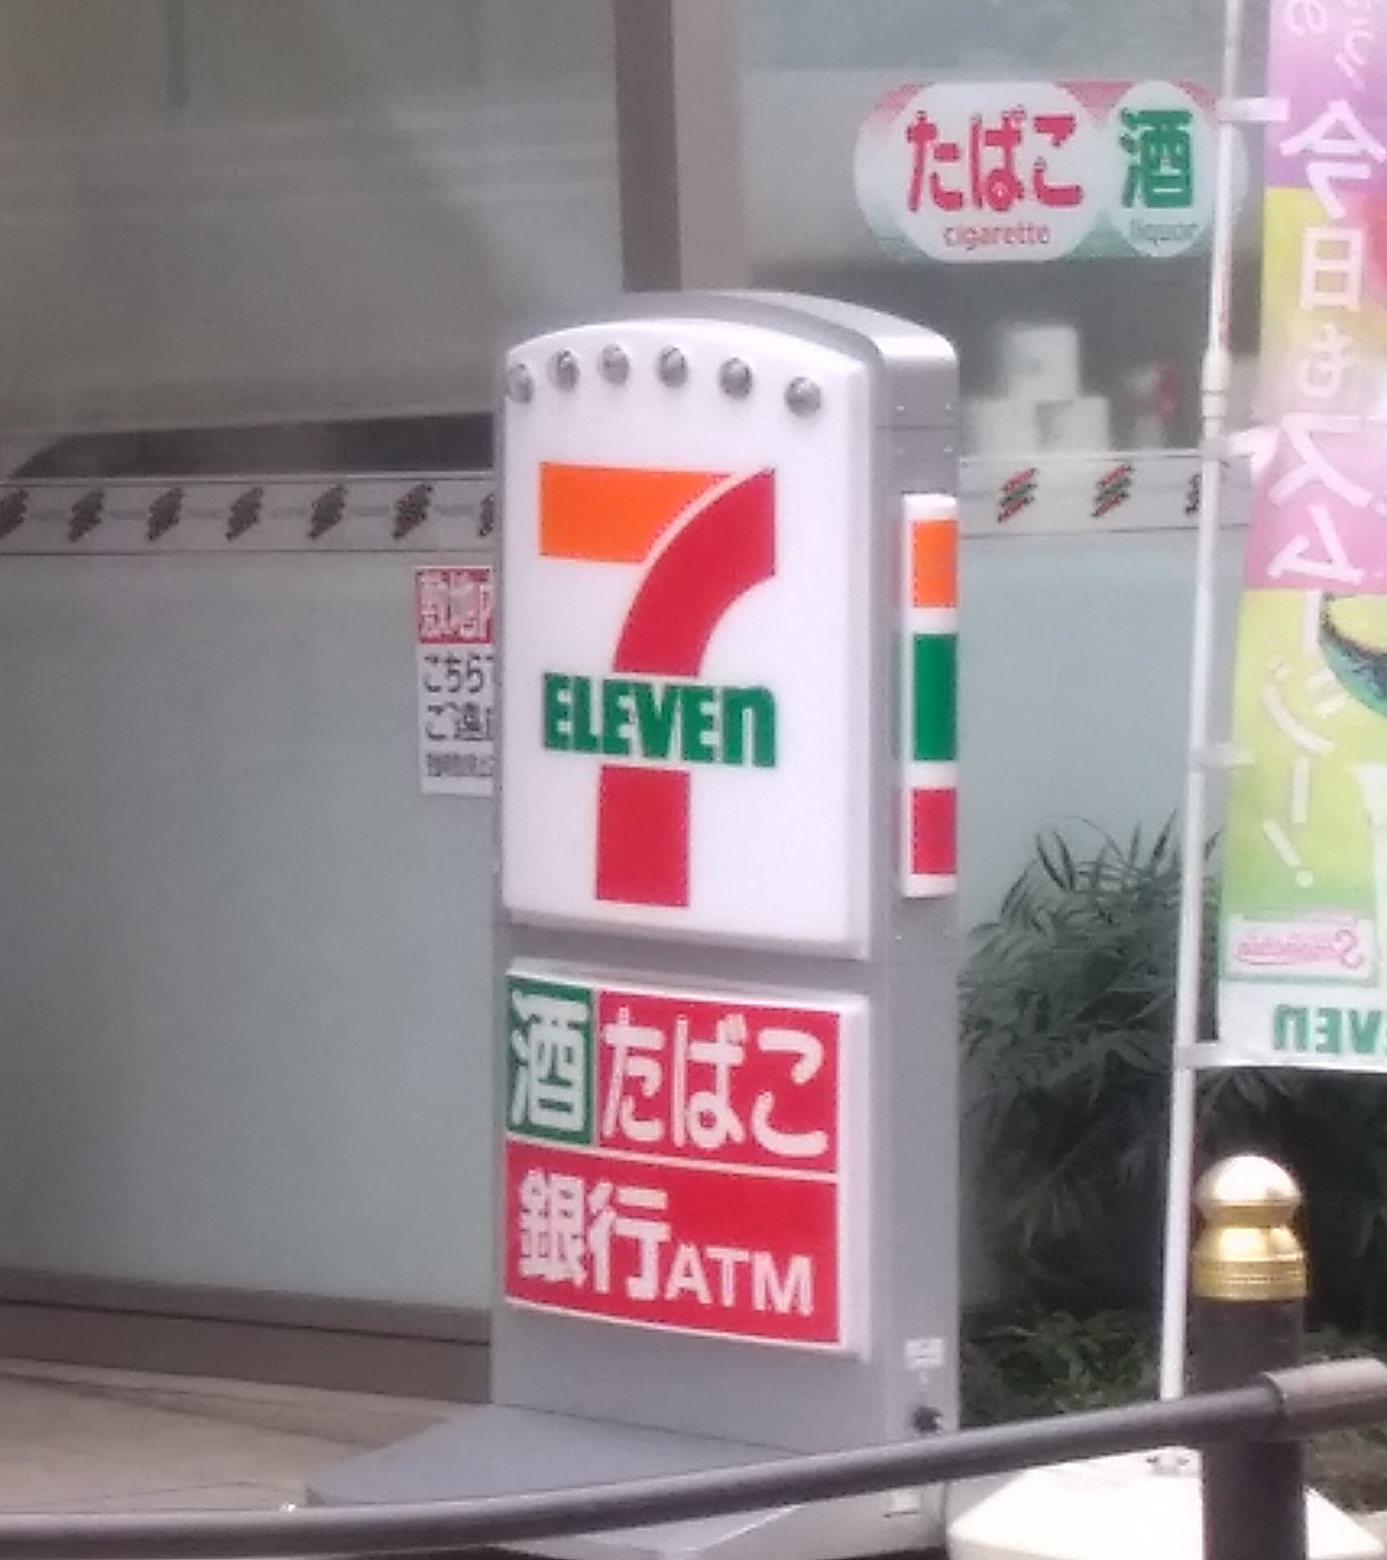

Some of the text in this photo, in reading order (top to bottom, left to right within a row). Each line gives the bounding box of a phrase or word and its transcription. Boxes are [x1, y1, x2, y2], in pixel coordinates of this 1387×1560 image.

[905, 104, 1194, 212] たばこ 酒
[944, 221, 1051, 251] cigarette
[511, 989, 829, 1159] 酒 たばこ
[518, 1167, 815, 1319] 銀行ATM
